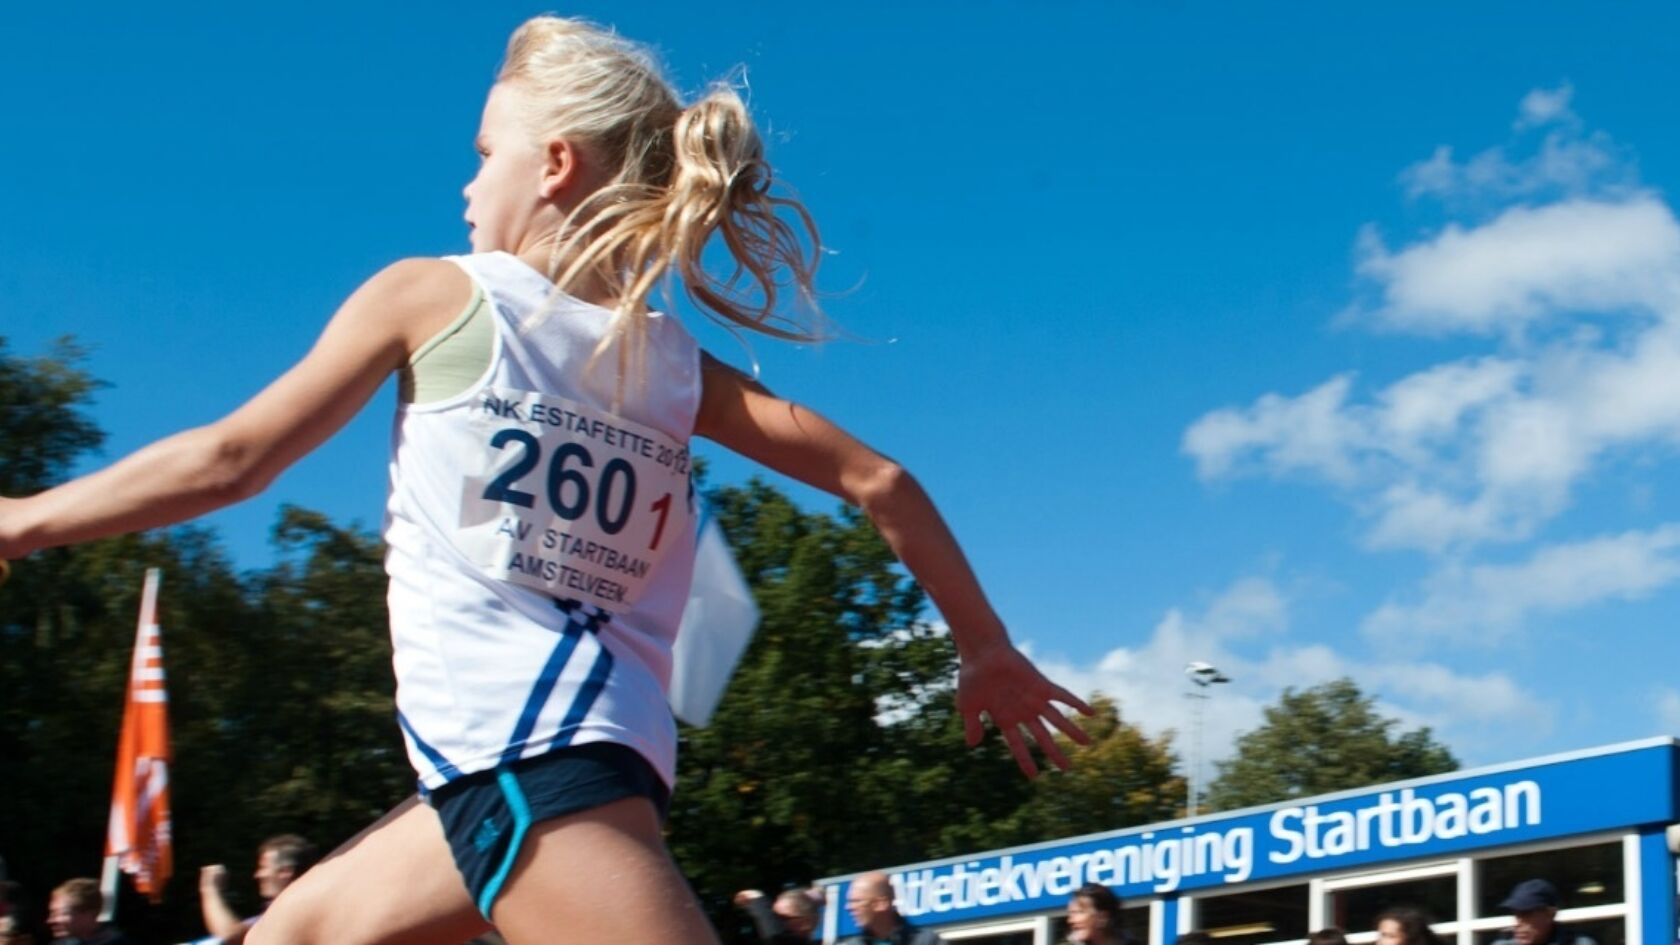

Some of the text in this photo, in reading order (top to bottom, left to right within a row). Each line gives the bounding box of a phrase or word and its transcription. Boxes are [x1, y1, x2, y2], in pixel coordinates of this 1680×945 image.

[484, 398, 520, 421] NK
[531, 403, 655, 458] ESTAFETTE
[481, 428, 636, 535] 260
[498, 517, 650, 579] AV STARTBAAN
[648, 492, 672, 550] 1
[509, 552, 627, 603] AMSTELVEEN
[1268, 779, 1541, 865] Startbaan
